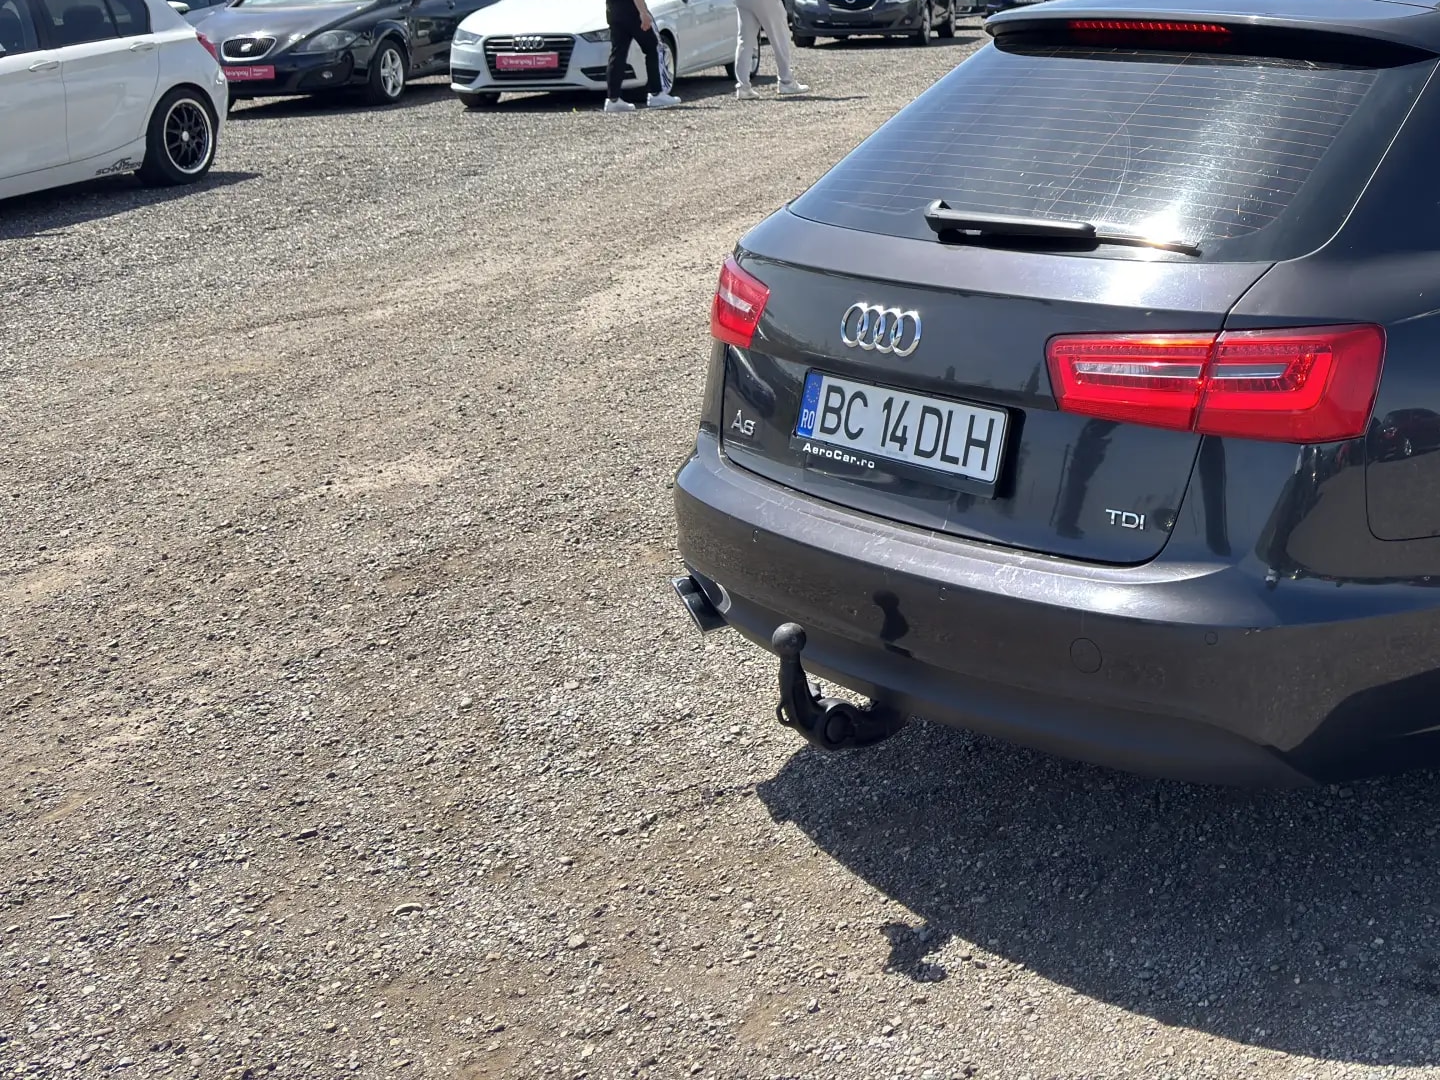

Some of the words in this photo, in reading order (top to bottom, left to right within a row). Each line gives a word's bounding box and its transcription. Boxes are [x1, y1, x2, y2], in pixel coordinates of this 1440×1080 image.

[225, 69, 249, 77] leanpay
[730, 409, 756, 436] A6
[800, 408, 816, 430] RO
[819, 384, 869, 441] BC
[879, 396, 911, 452] 14
[913, 404, 996, 472] DLH
[802, 442, 876, 469] AeroCar.ro
[1105, 508, 1145, 530] TDI
